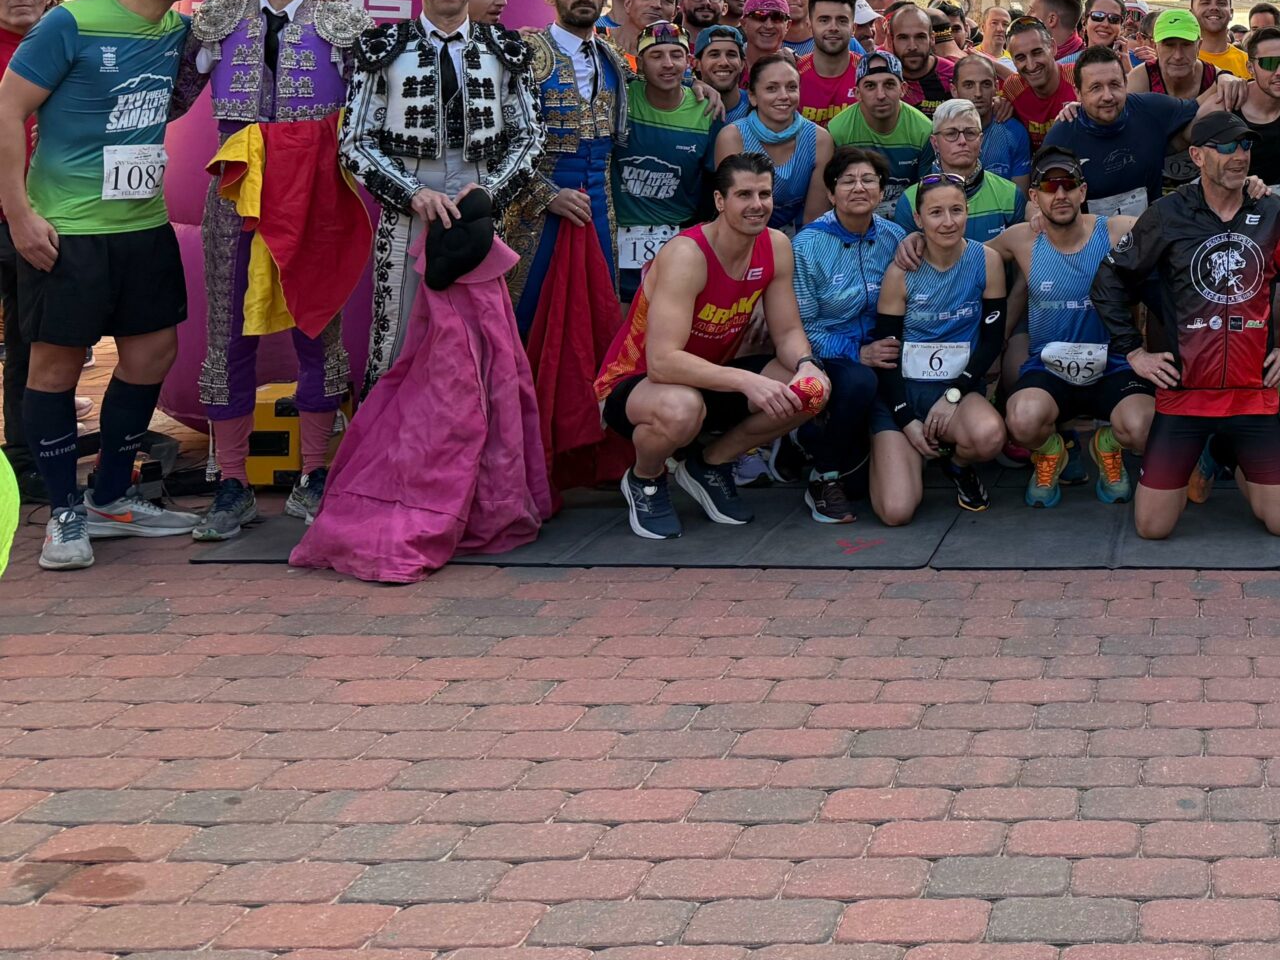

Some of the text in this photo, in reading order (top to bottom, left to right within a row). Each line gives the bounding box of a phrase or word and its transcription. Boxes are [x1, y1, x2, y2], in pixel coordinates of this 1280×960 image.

[114, 90, 147, 112] XXV
[145, 87, 170, 100] VUELT
[106, 104, 167, 131] SANBLA
[622, 166, 651, 181] XXV
[630, 240, 666, 262] 18
[929, 348, 944, 371] 6
[1052, 359, 1095, 379] 305
